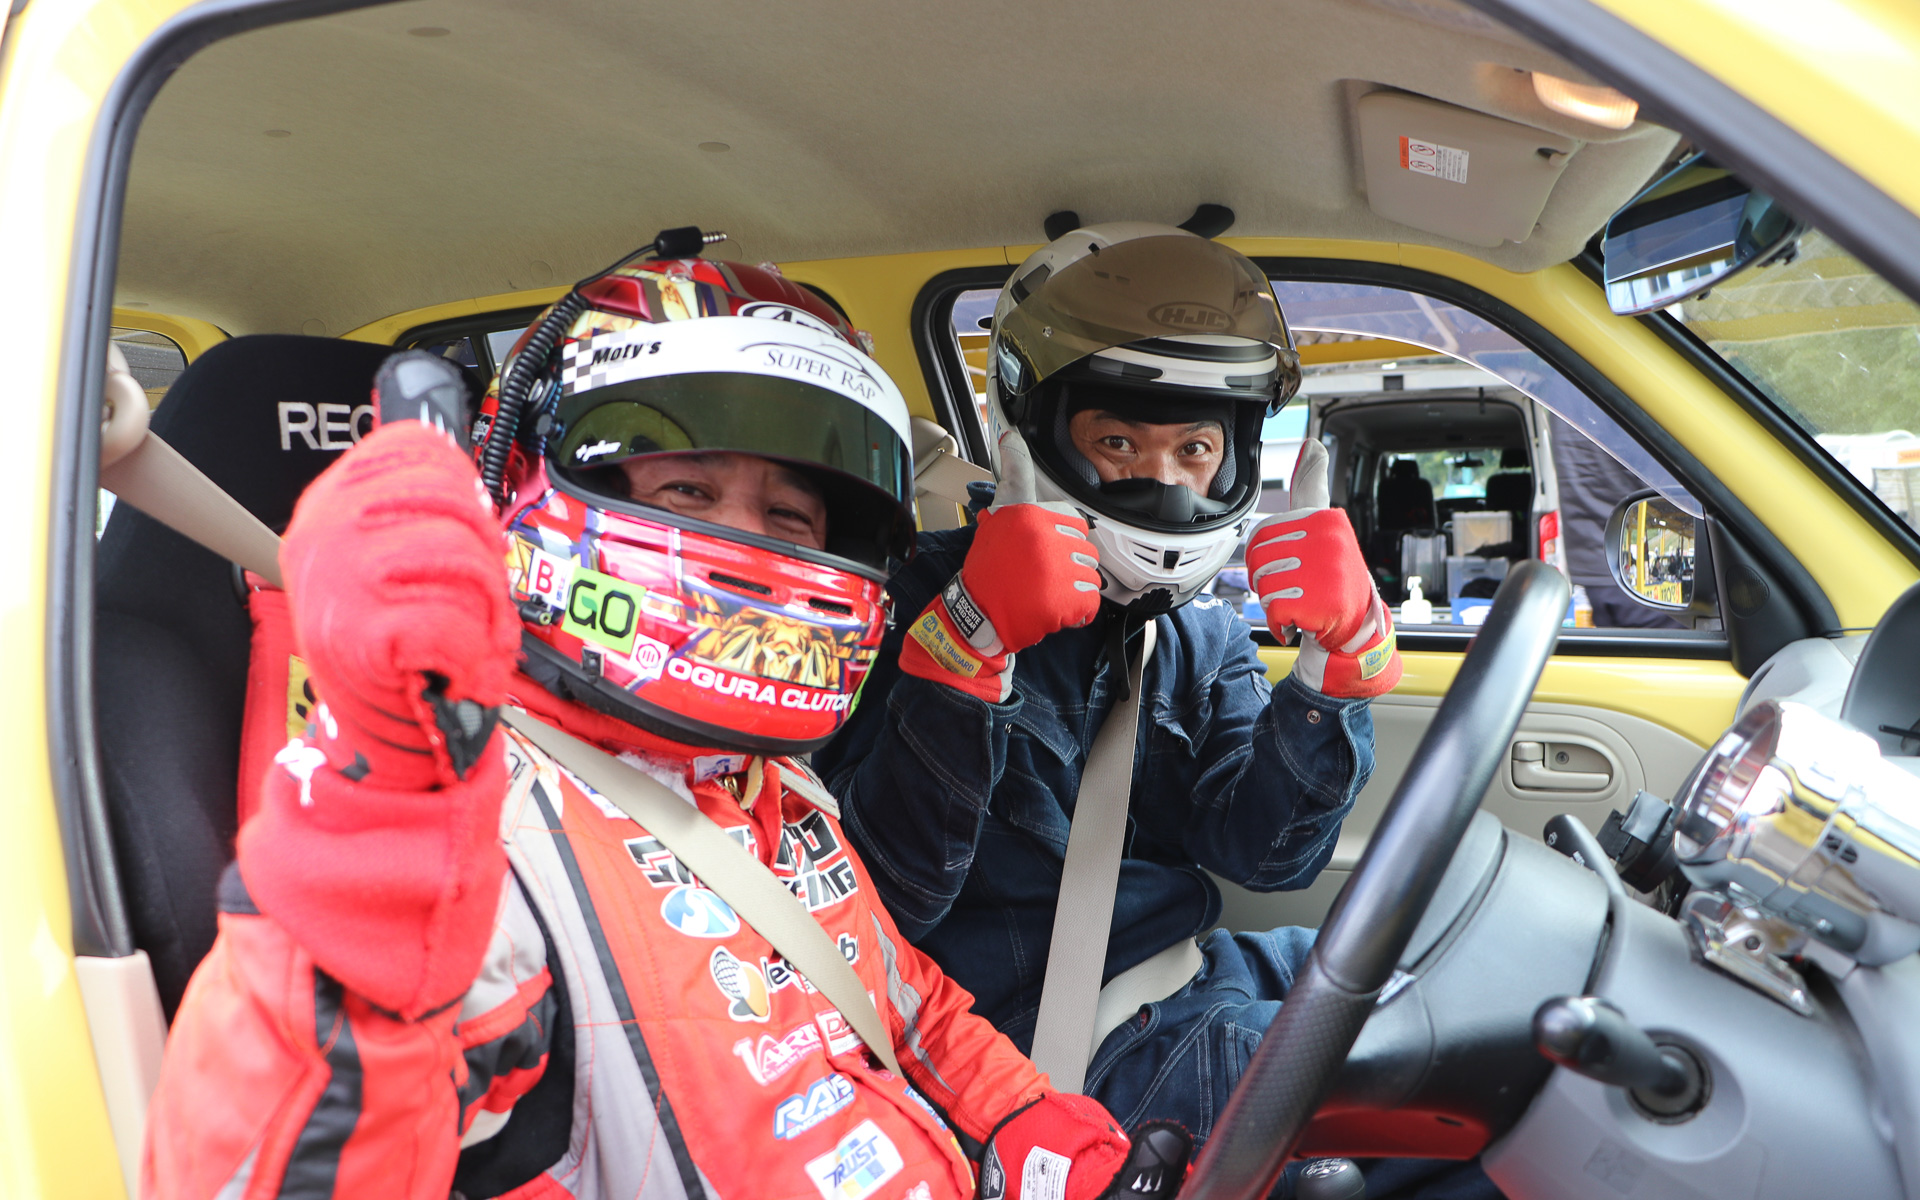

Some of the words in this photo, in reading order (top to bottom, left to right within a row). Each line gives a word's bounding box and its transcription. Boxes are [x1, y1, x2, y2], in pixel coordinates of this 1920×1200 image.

[1160, 307, 1226, 328] HJC
[591, 341, 662, 366] Moty's
[763, 349, 832, 380] SUPER
[841, 369, 876, 400] RAP
[535, 558, 555, 594] B
[568, 579, 637, 640] GO
[923, 616, 938, 633] FIA
[955, 601, 967, 619] SPEED
[964, 616, 978, 631] GEAR
[959, 595, 982, 626] DESCENTE
[943, 642, 975, 673] STANDARD
[667, 657, 776, 705] OGURA
[780, 688, 853, 712] CLUTCH
[775, 1073, 853, 1136] RAYS
[823, 1135, 878, 1188] TRUST
